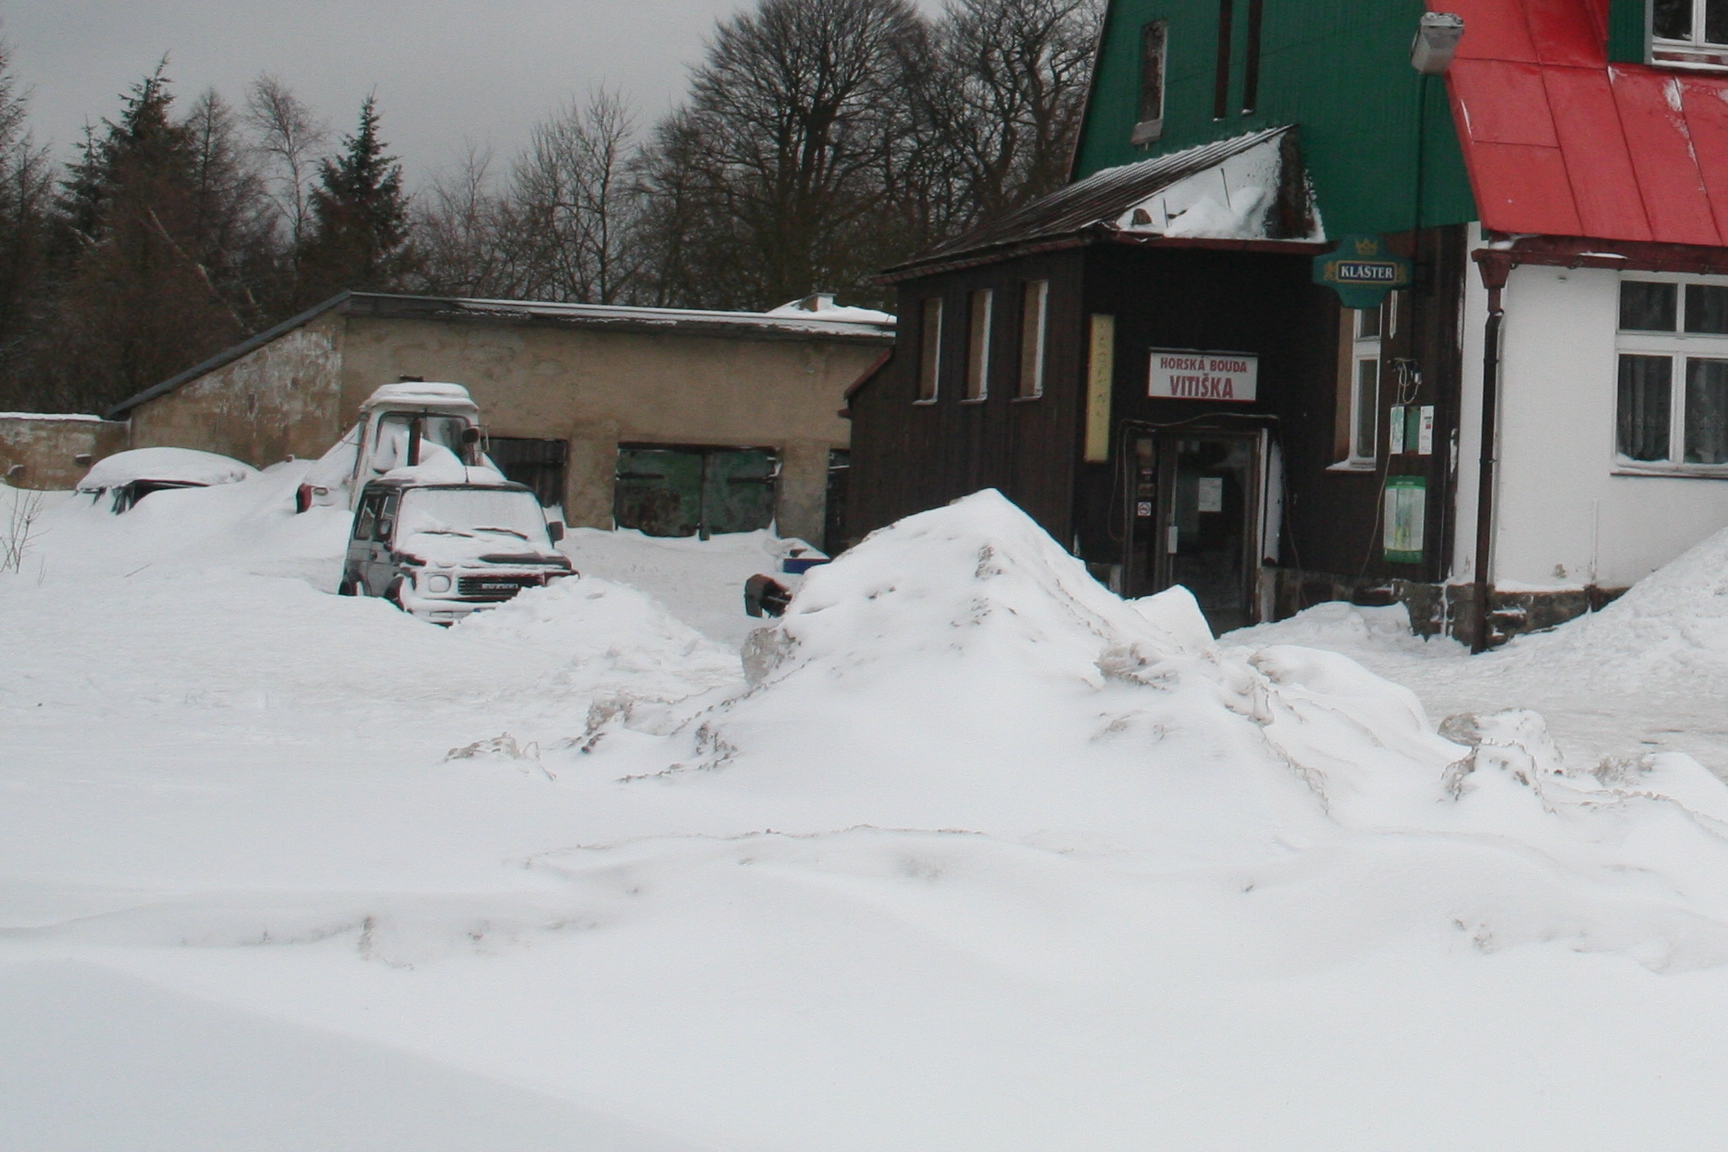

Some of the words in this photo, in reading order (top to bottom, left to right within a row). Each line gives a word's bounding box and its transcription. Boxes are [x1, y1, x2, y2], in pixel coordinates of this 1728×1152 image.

[1160, 355, 1205, 371] HORSKÁ
[1210, 359, 1247, 373] BOUDA
[1169, 373, 1234, 399] VITIŠKA
